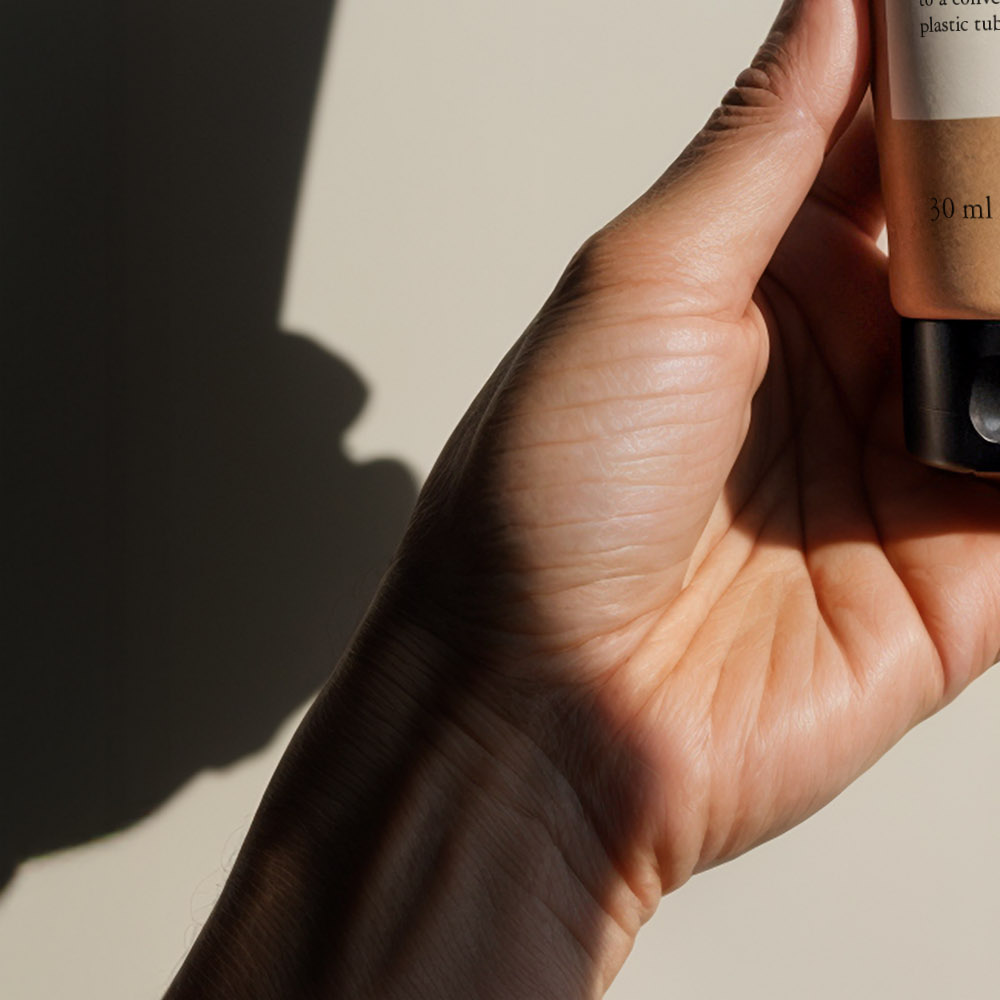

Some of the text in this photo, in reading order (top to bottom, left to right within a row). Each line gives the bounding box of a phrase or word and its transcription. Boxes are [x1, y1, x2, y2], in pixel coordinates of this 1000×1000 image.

[920, 16, 969, 38] plastic
[930, 197, 955, 222] 30
[962, 196, 993, 219] ml
